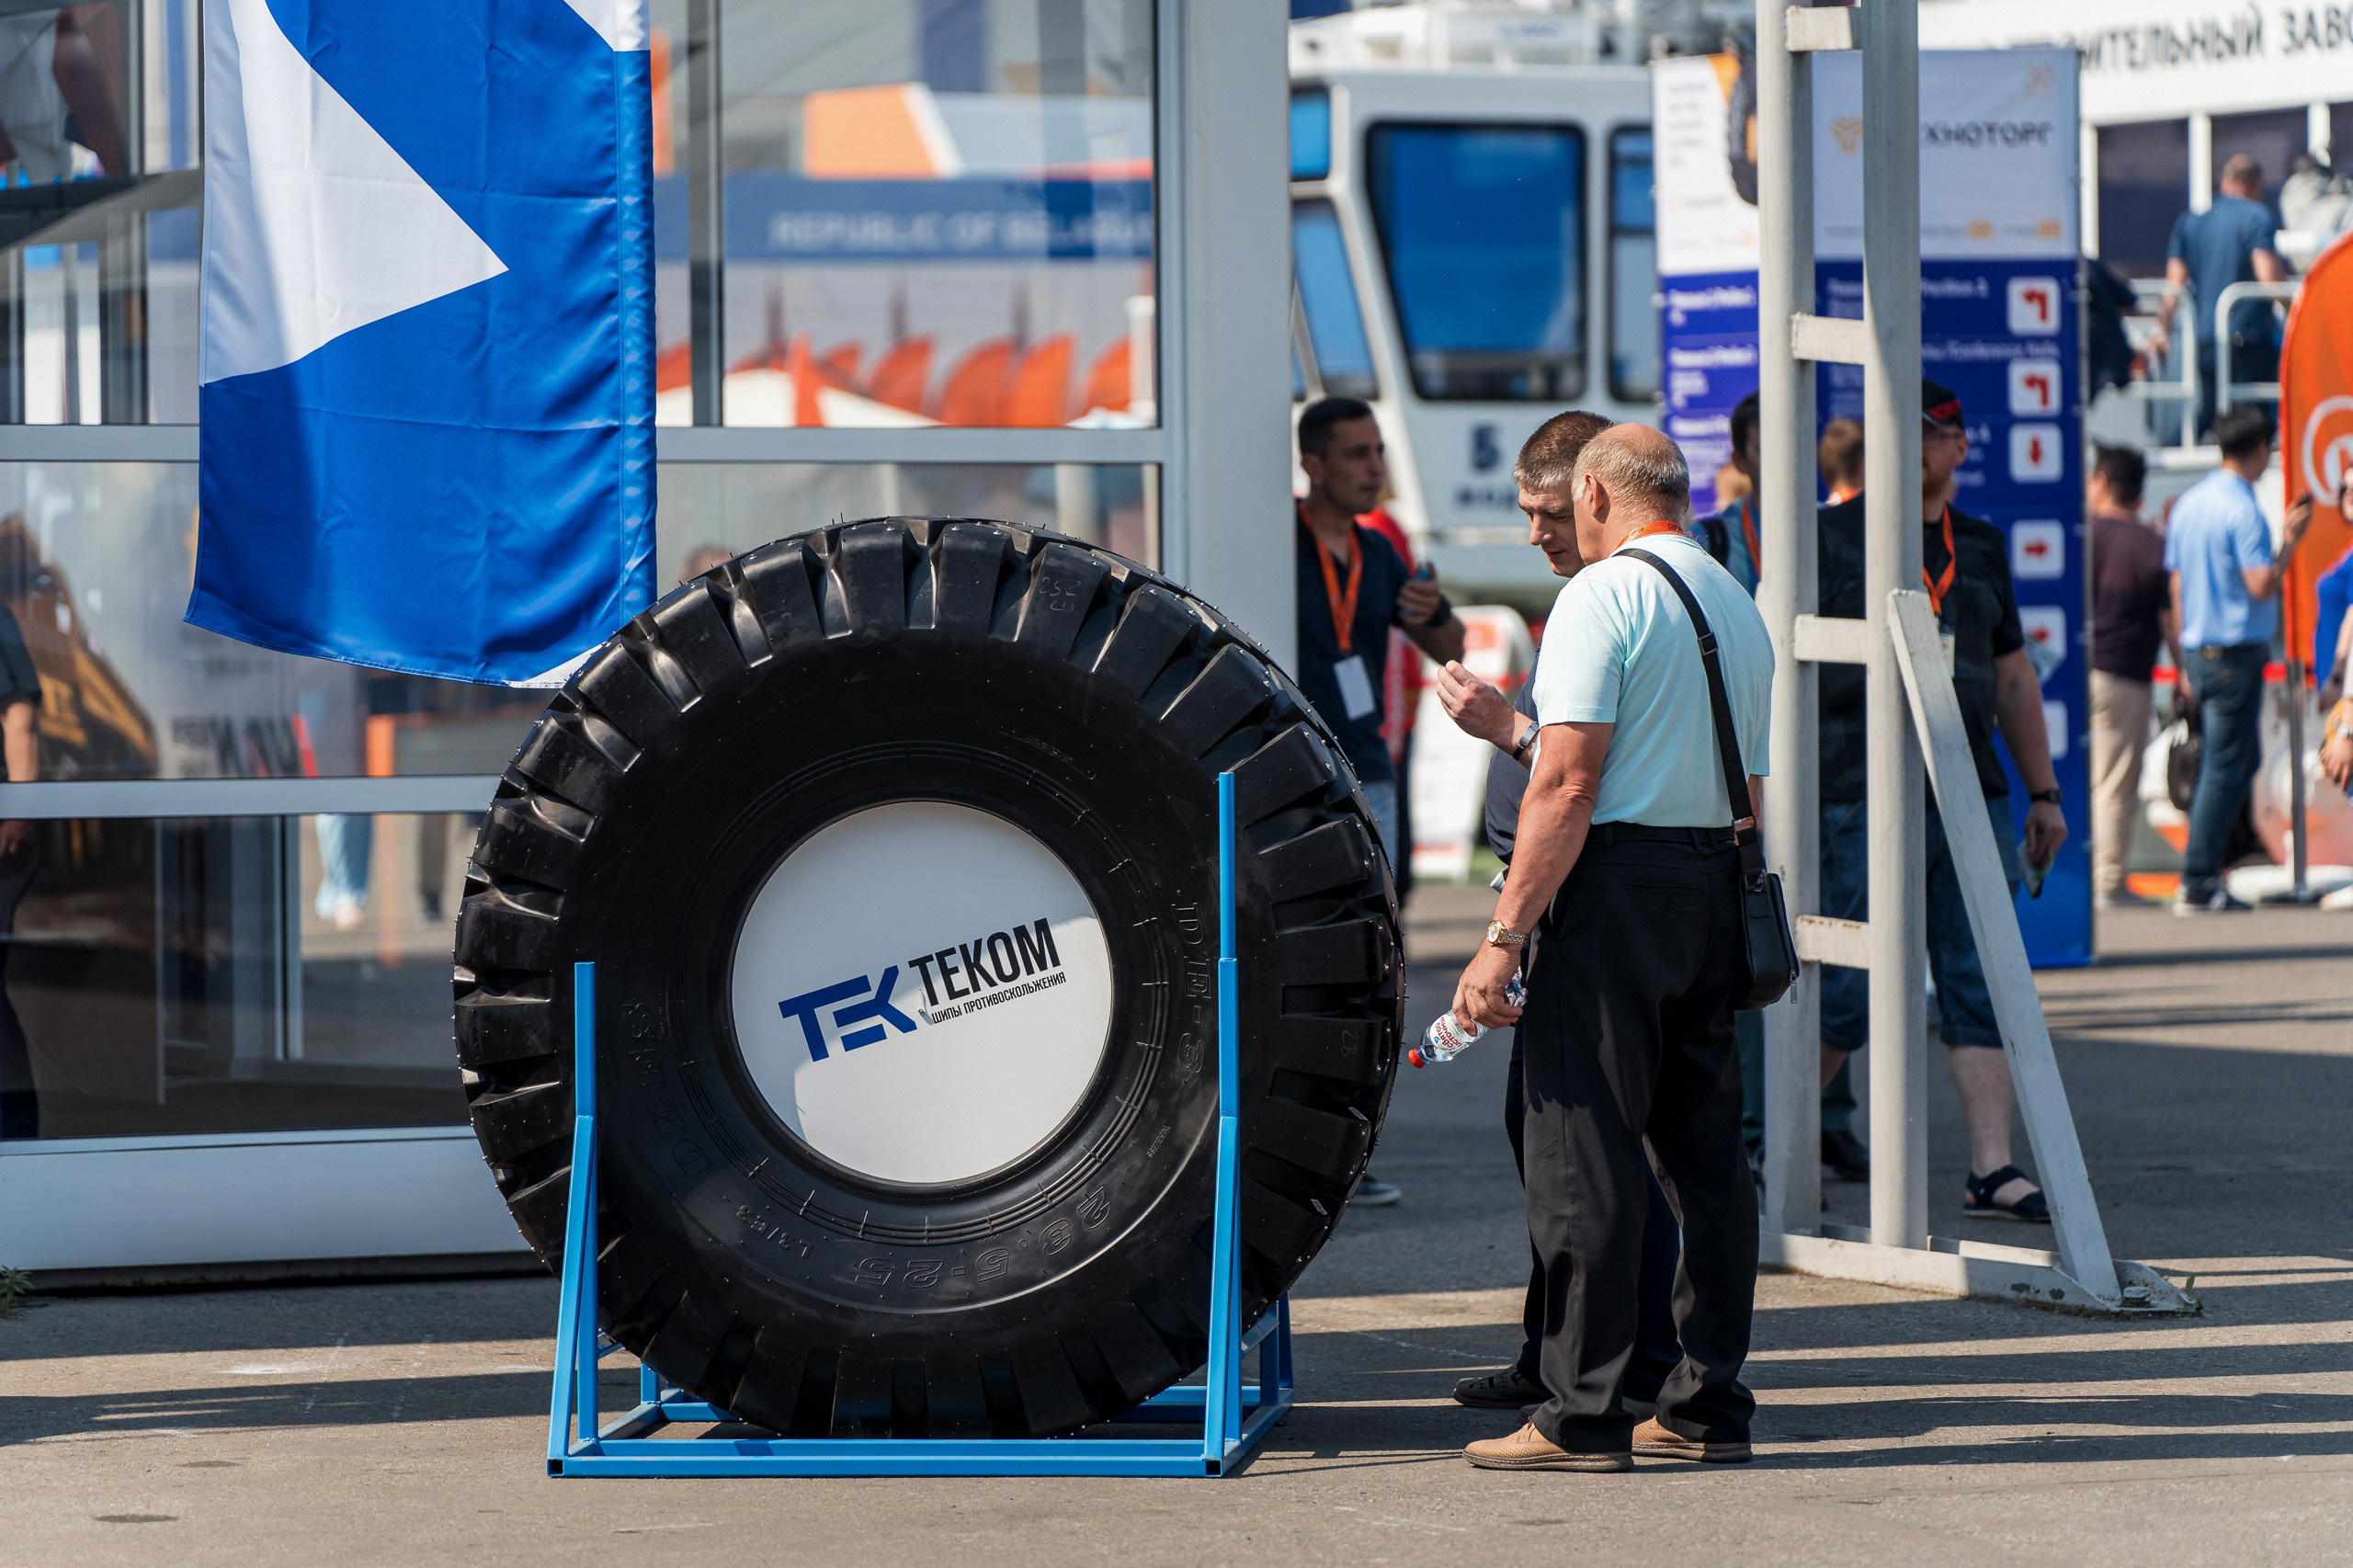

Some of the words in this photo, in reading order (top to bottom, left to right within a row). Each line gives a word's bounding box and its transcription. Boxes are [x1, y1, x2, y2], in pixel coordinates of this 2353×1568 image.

[1921, 120, 2052, 149] ХНОТОРГ
[908, 917, 1061, 1006] ТЕКОМ
[931, 1005, 963, 1025] ШИПЫ
[963, 971, 1067, 1015] ПРОТИВОСКОЛЬЖЕНИЯ
